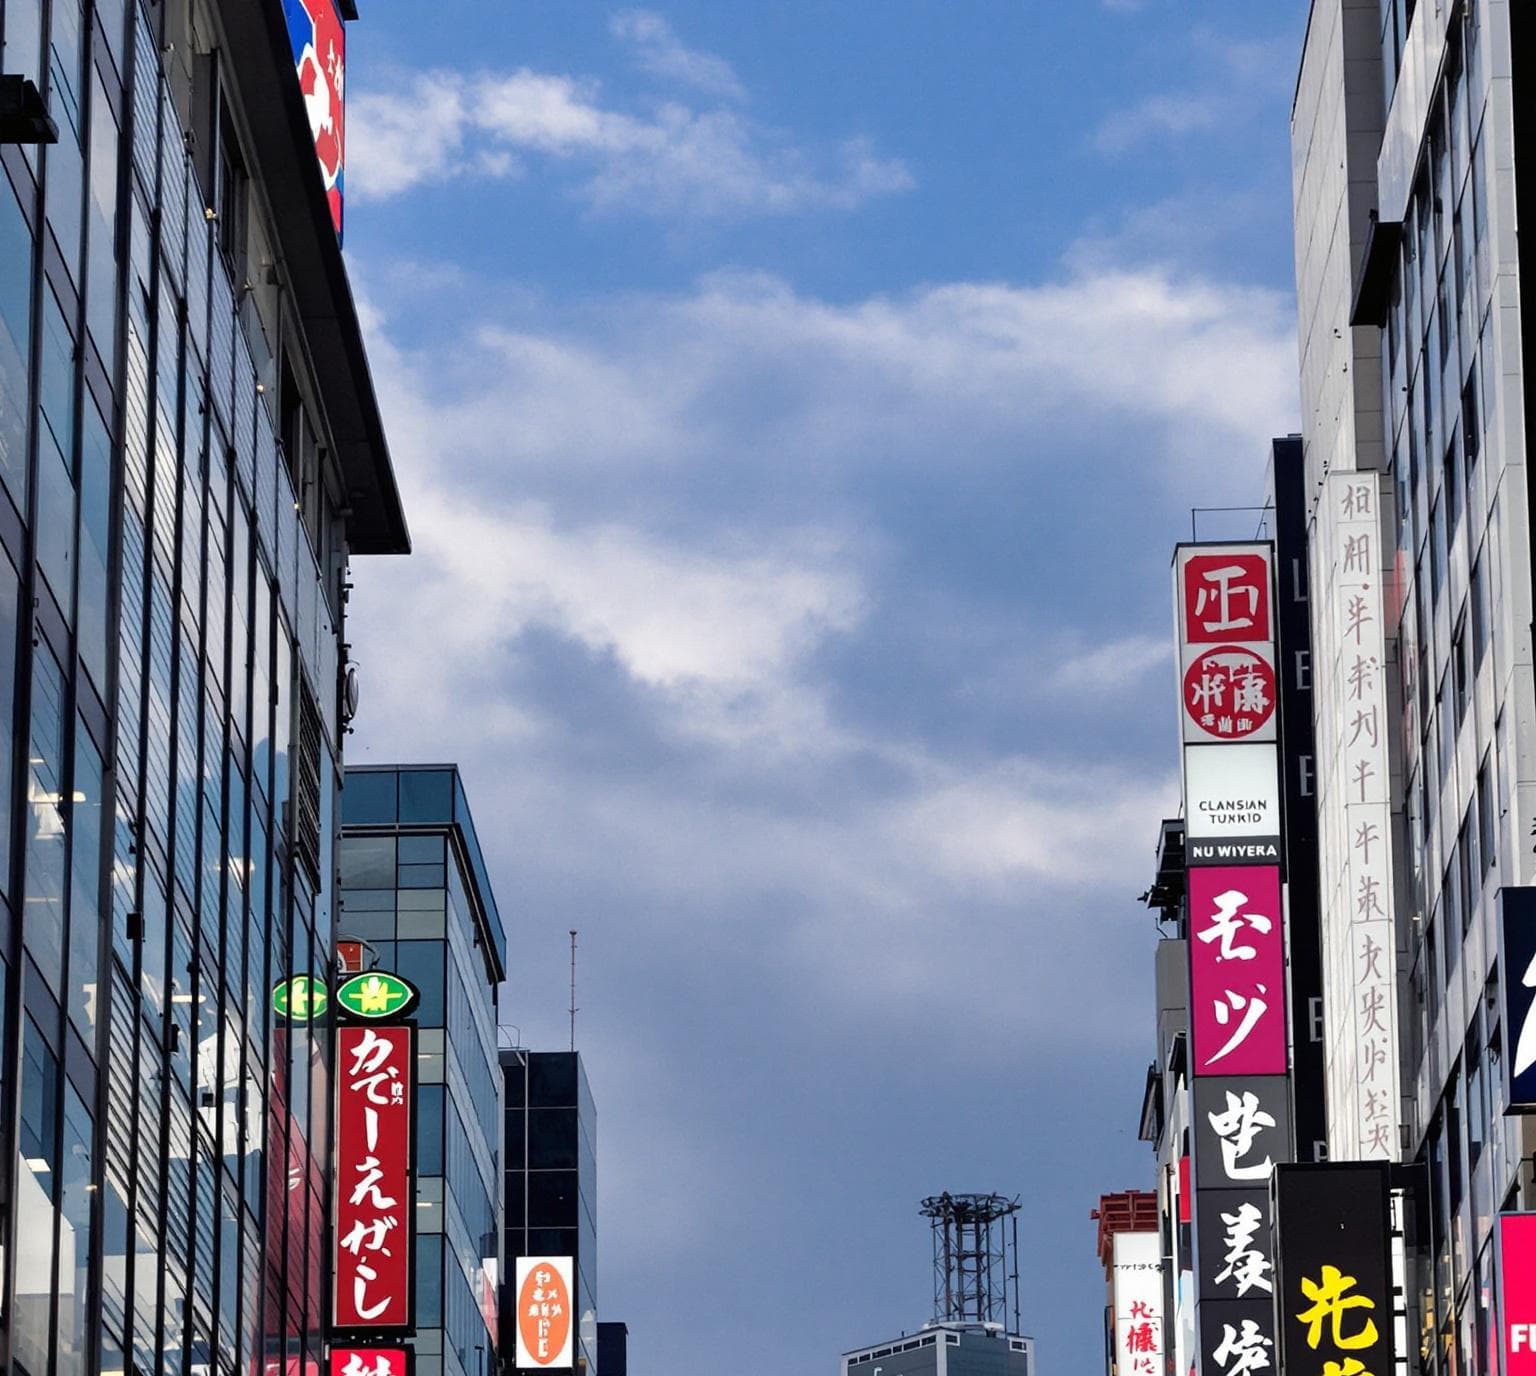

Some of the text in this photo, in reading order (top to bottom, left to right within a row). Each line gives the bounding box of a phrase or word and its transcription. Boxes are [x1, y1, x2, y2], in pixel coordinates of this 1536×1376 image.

[1199, 799, 1267, 811] CLANSIAN
[1193, 844, 1277, 858] NU WIYERA
